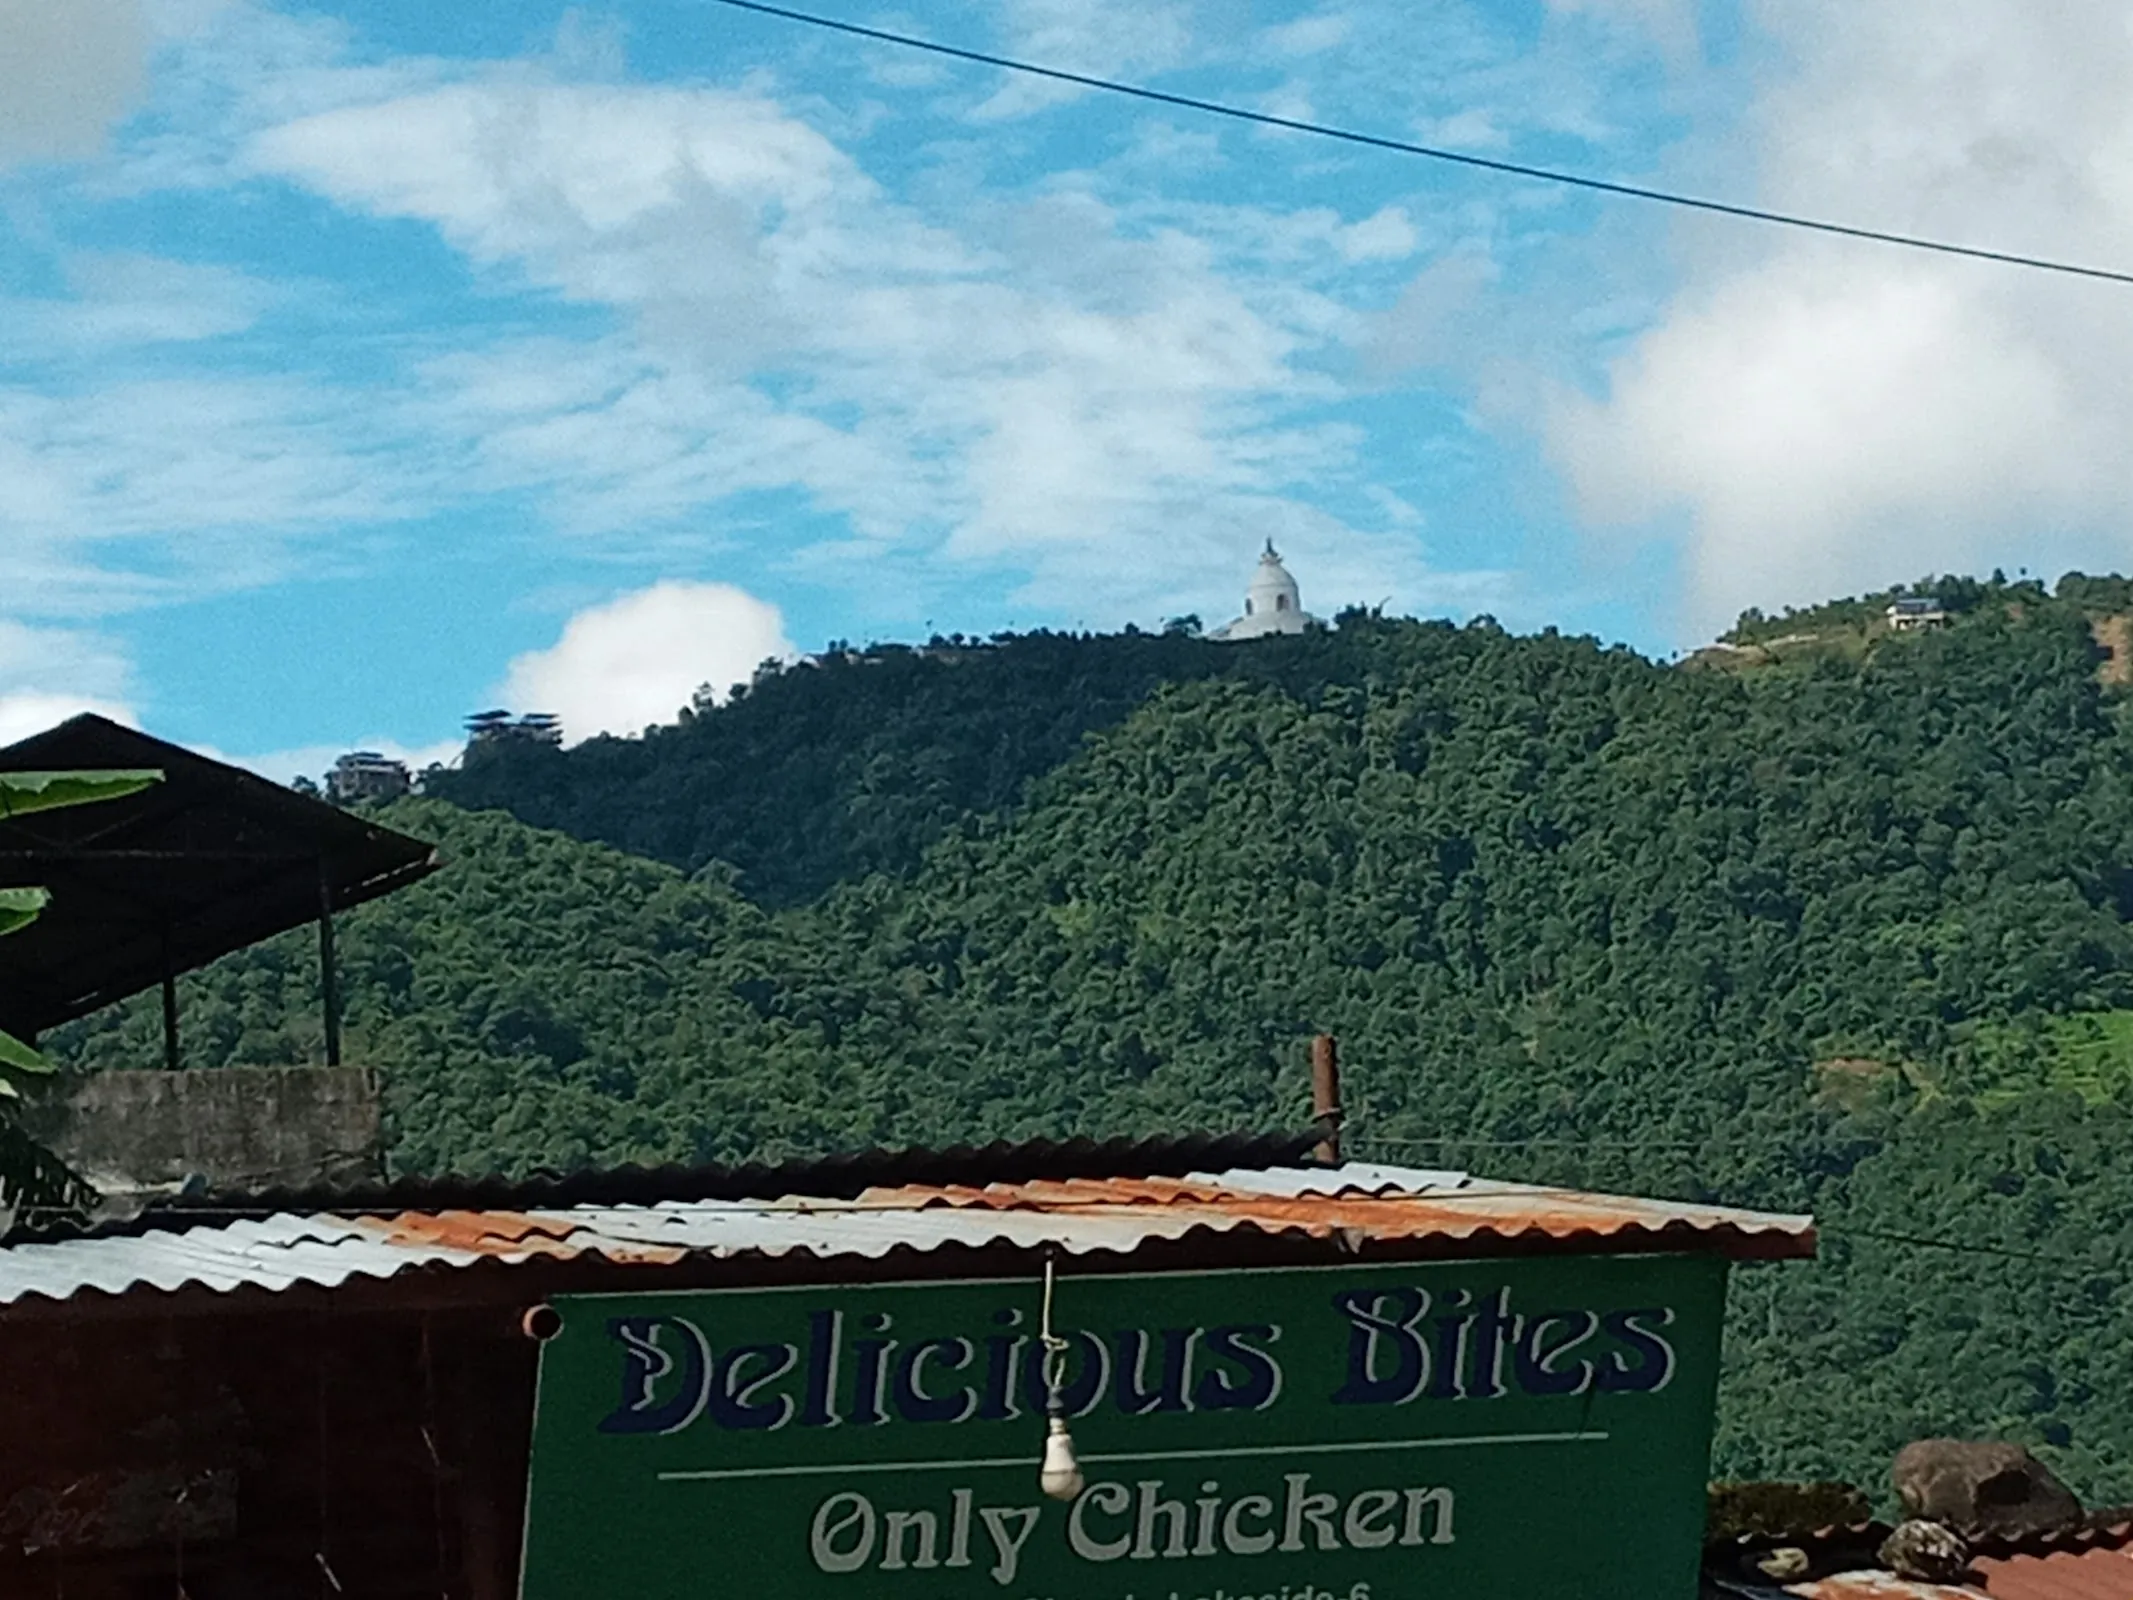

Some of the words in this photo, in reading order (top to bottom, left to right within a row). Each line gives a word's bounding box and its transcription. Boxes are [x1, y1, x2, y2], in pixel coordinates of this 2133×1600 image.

[597, 1308, 1283, 1434] Delicious
[1329, 1286, 1675, 1405] Bites
[811, 1488, 1040, 1585] Only
[1069, 1473, 1456, 1561] Chicken
